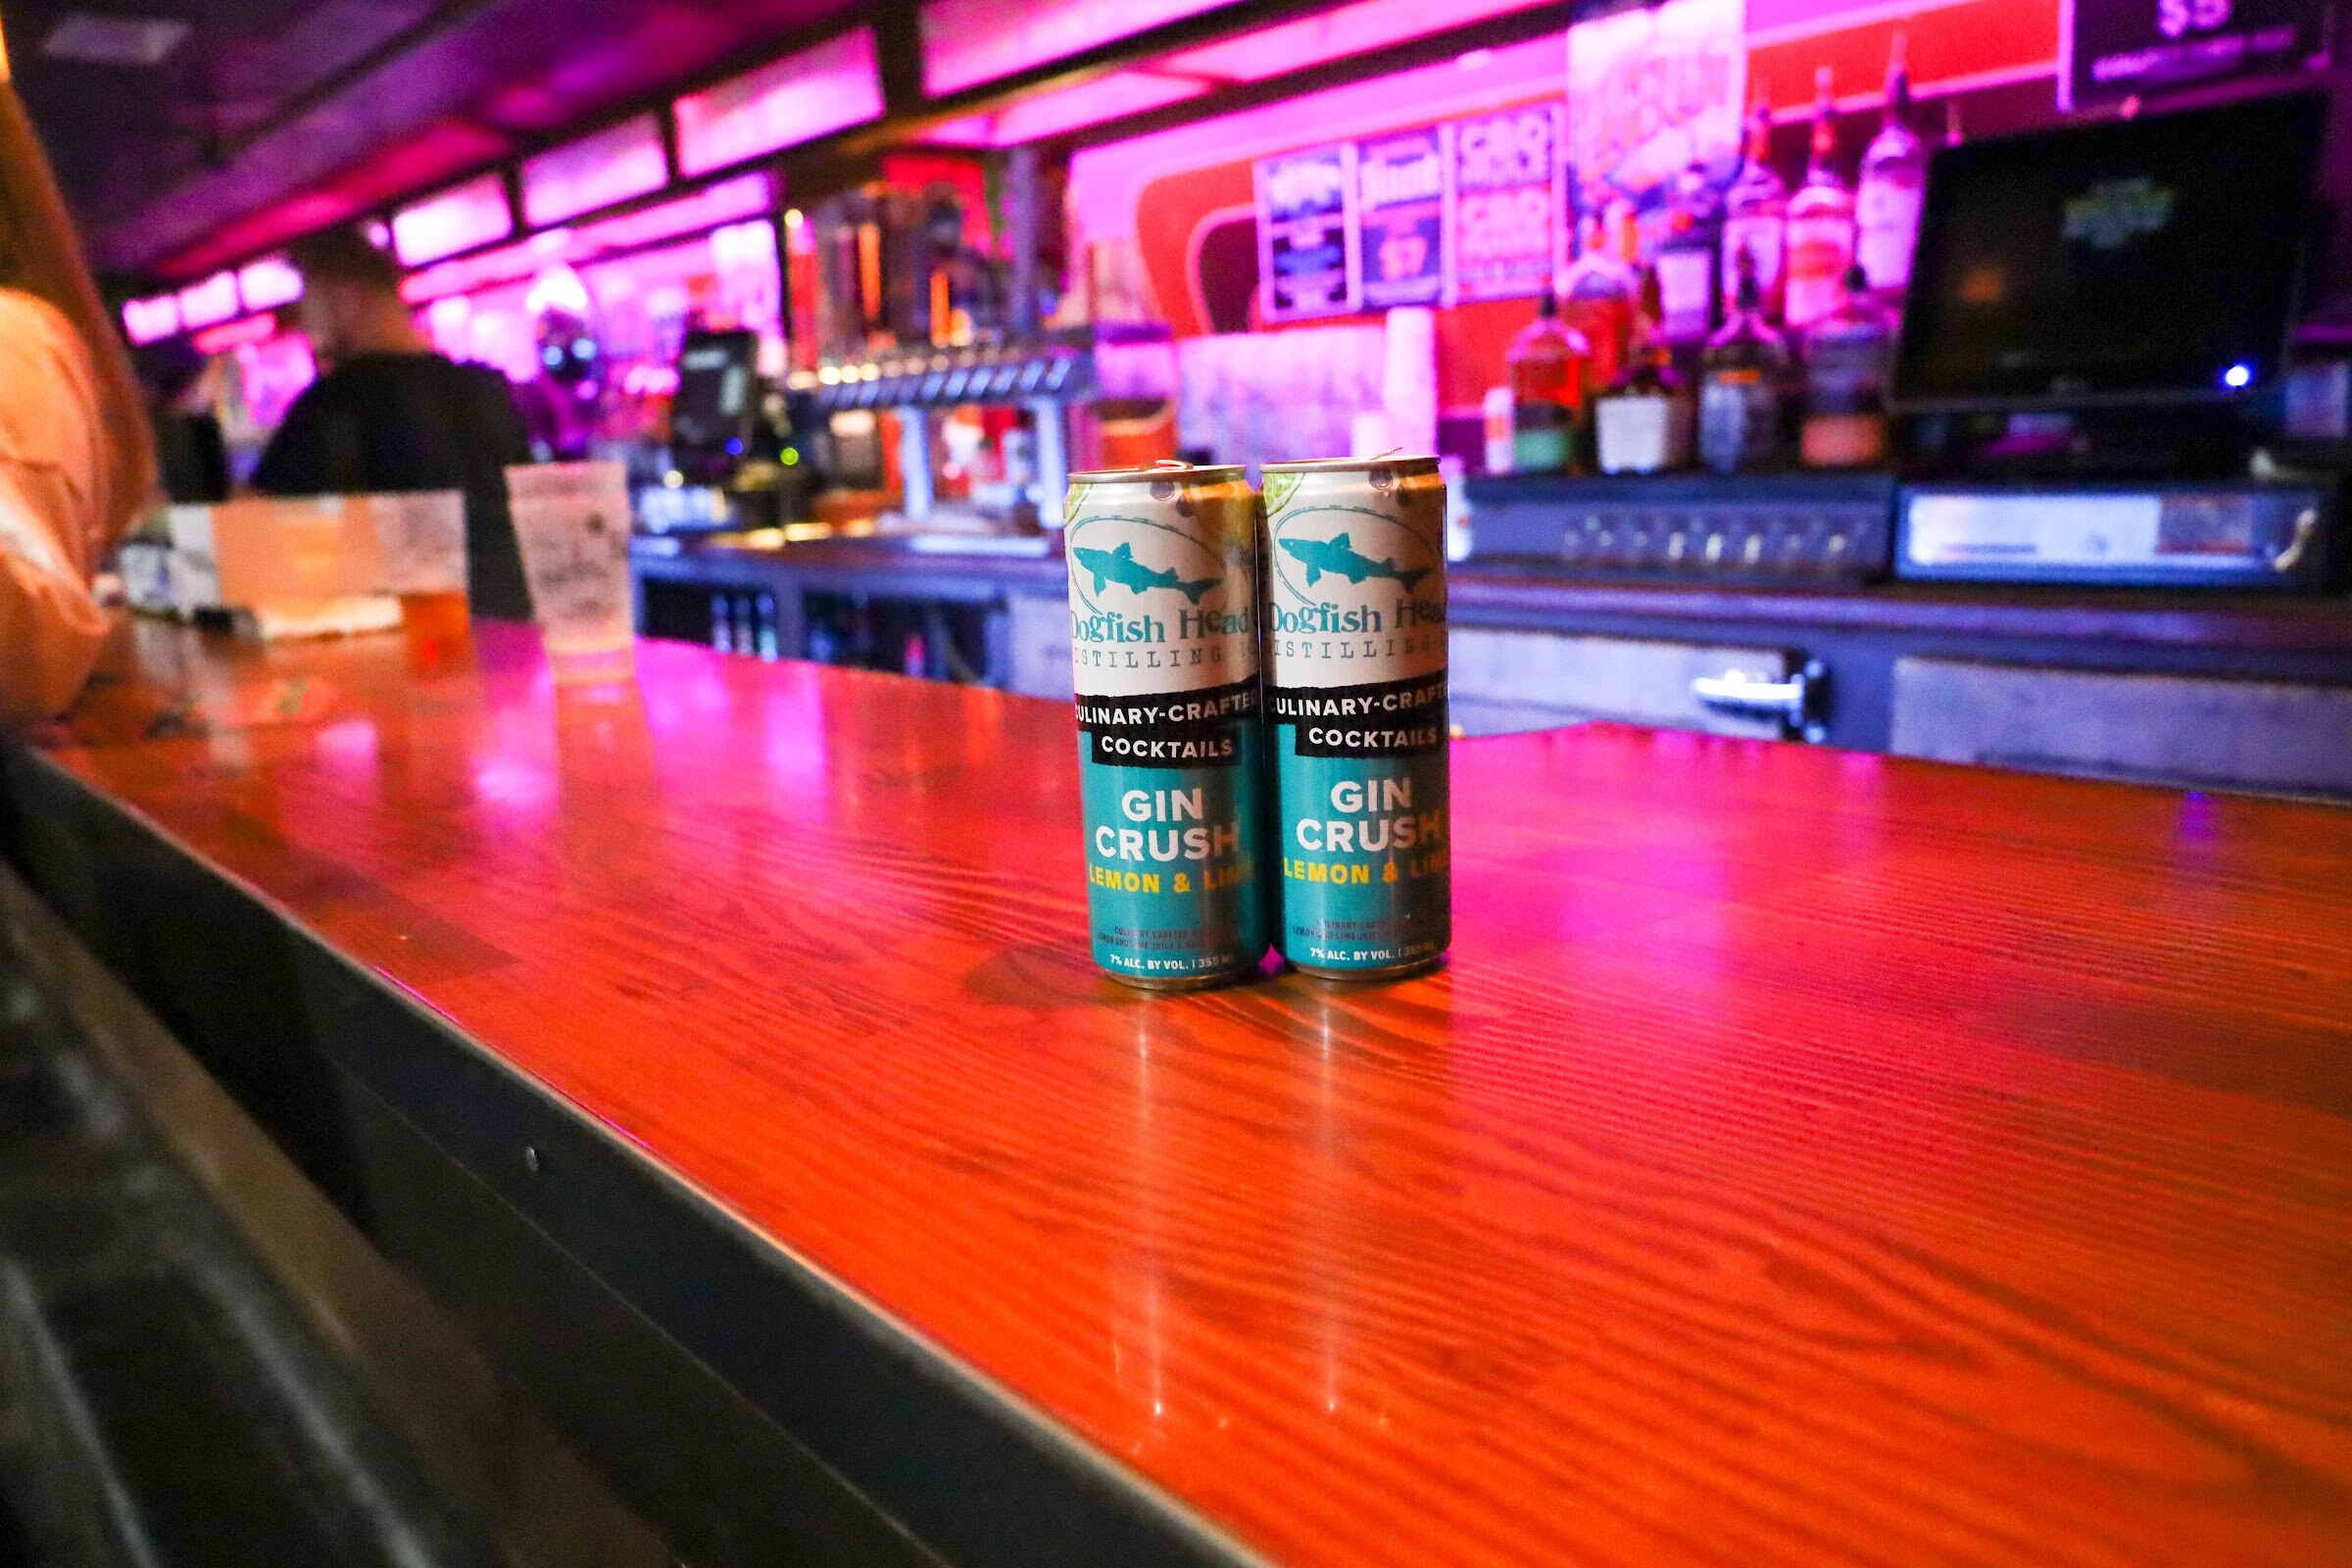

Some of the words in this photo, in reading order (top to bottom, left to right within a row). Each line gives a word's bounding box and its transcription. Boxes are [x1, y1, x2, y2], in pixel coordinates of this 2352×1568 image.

[1070, 611, 1165, 643] Dogfish
[1179, 607, 1250, 639] Head
[1270, 602, 1381, 634] Dogfish
[1101, 735, 1234, 759] COCKTAILS
[1308, 727, 1438, 748] COCKTAILS
[1121, 787, 1203, 822] GIN
[1330, 777, 1412, 812] GIN
[1096, 822, 1239, 862] CRUSH
[1296, 809, 1440, 853] CRUSH
[1088, 862, 1160, 894] LEMON
[1173, 872, 1192, 893] &
[1283, 857, 1370, 885] LEMON
[1110, 954, 1122, 965] 7%
[1124, 957, 1145, 969] ALC.
[1148, 959, 1160, 970] BY
[1163, 960, 1189, 970] VOL.
[1309, 948, 1324, 959] 7%
[1327, 950, 1349, 961] ALC.
[1353, 951, 1367, 960] BY
[1370, 949, 1394, 960] VOL.
